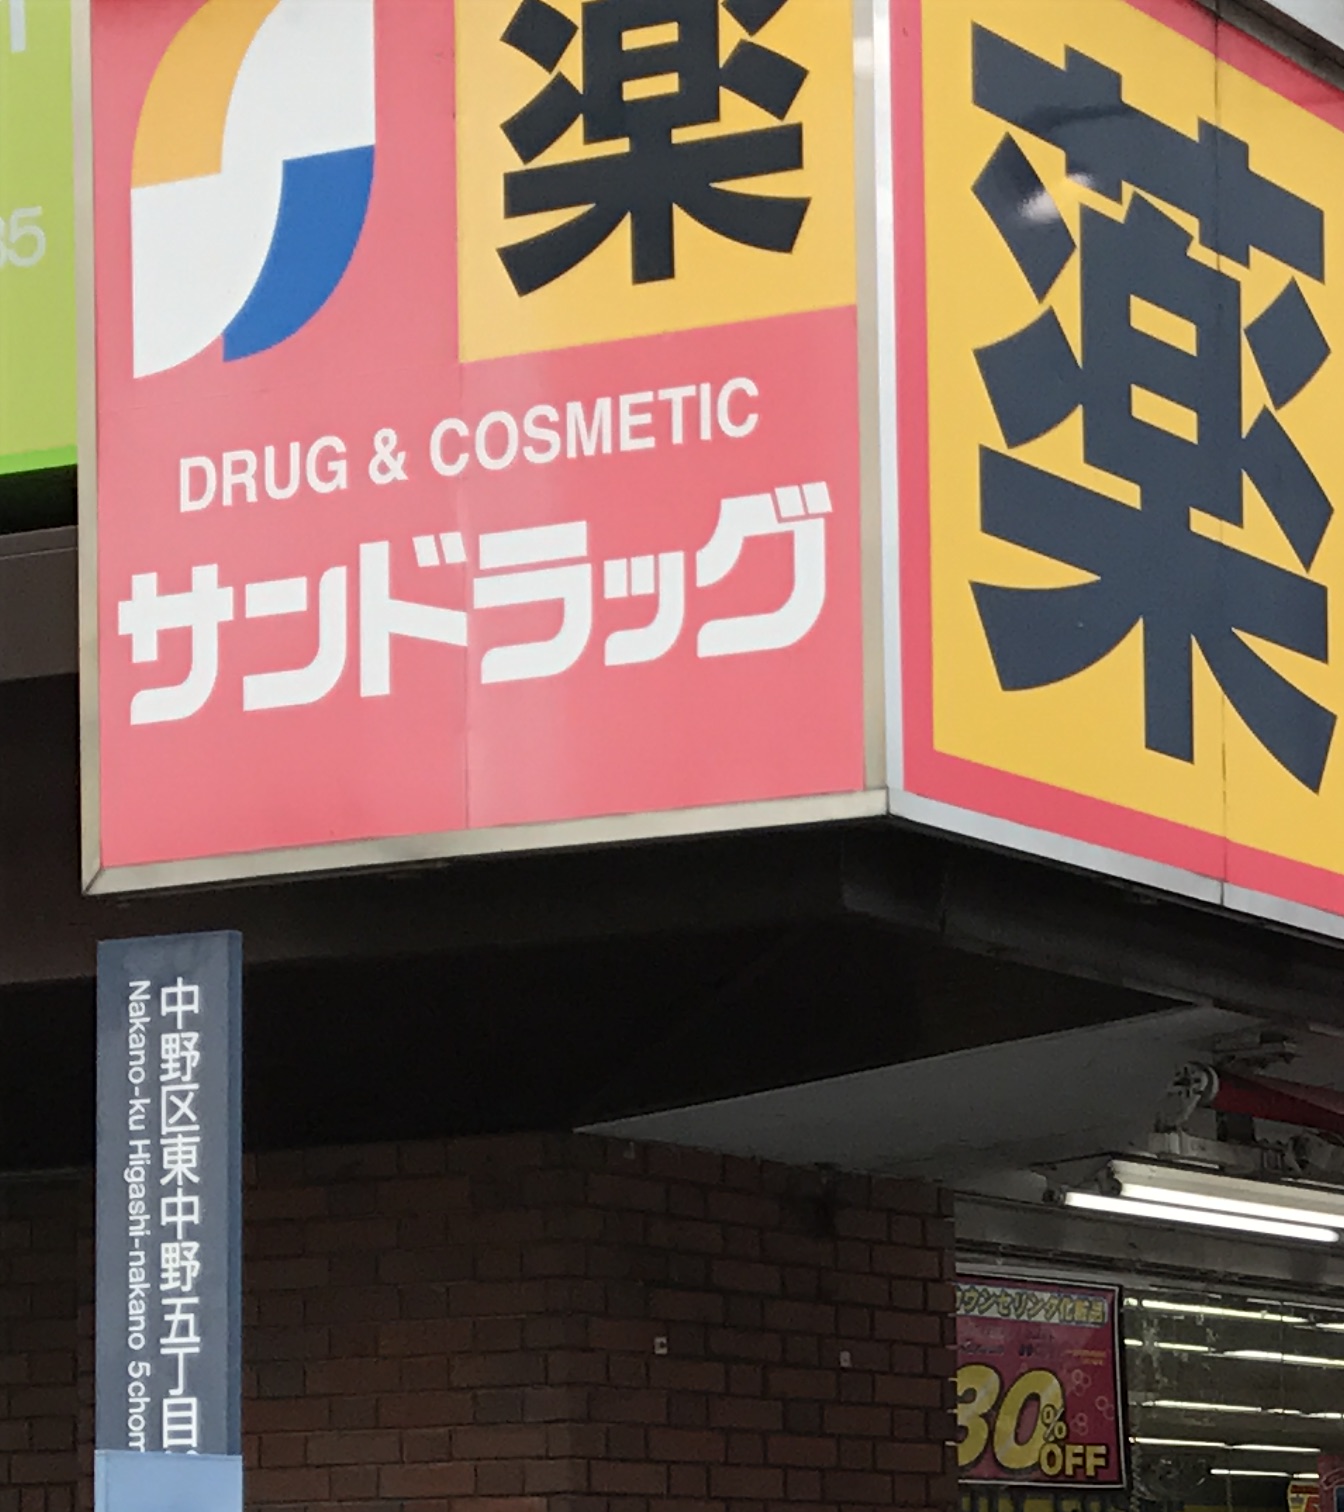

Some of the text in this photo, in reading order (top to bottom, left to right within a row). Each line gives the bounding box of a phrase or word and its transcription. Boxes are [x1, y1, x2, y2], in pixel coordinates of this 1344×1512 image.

[179, 377, 760, 513] DRUG & COSMETIC
[970, 21, 1337, 795] 薬
[118, 481, 833, 726] サンドラッグ
[127, 980, 152, 1131] Nakano-ku
[123, 1141, 152, 1350] Higashi-nakano
[1039, 1443, 1109, 1479] OFF
